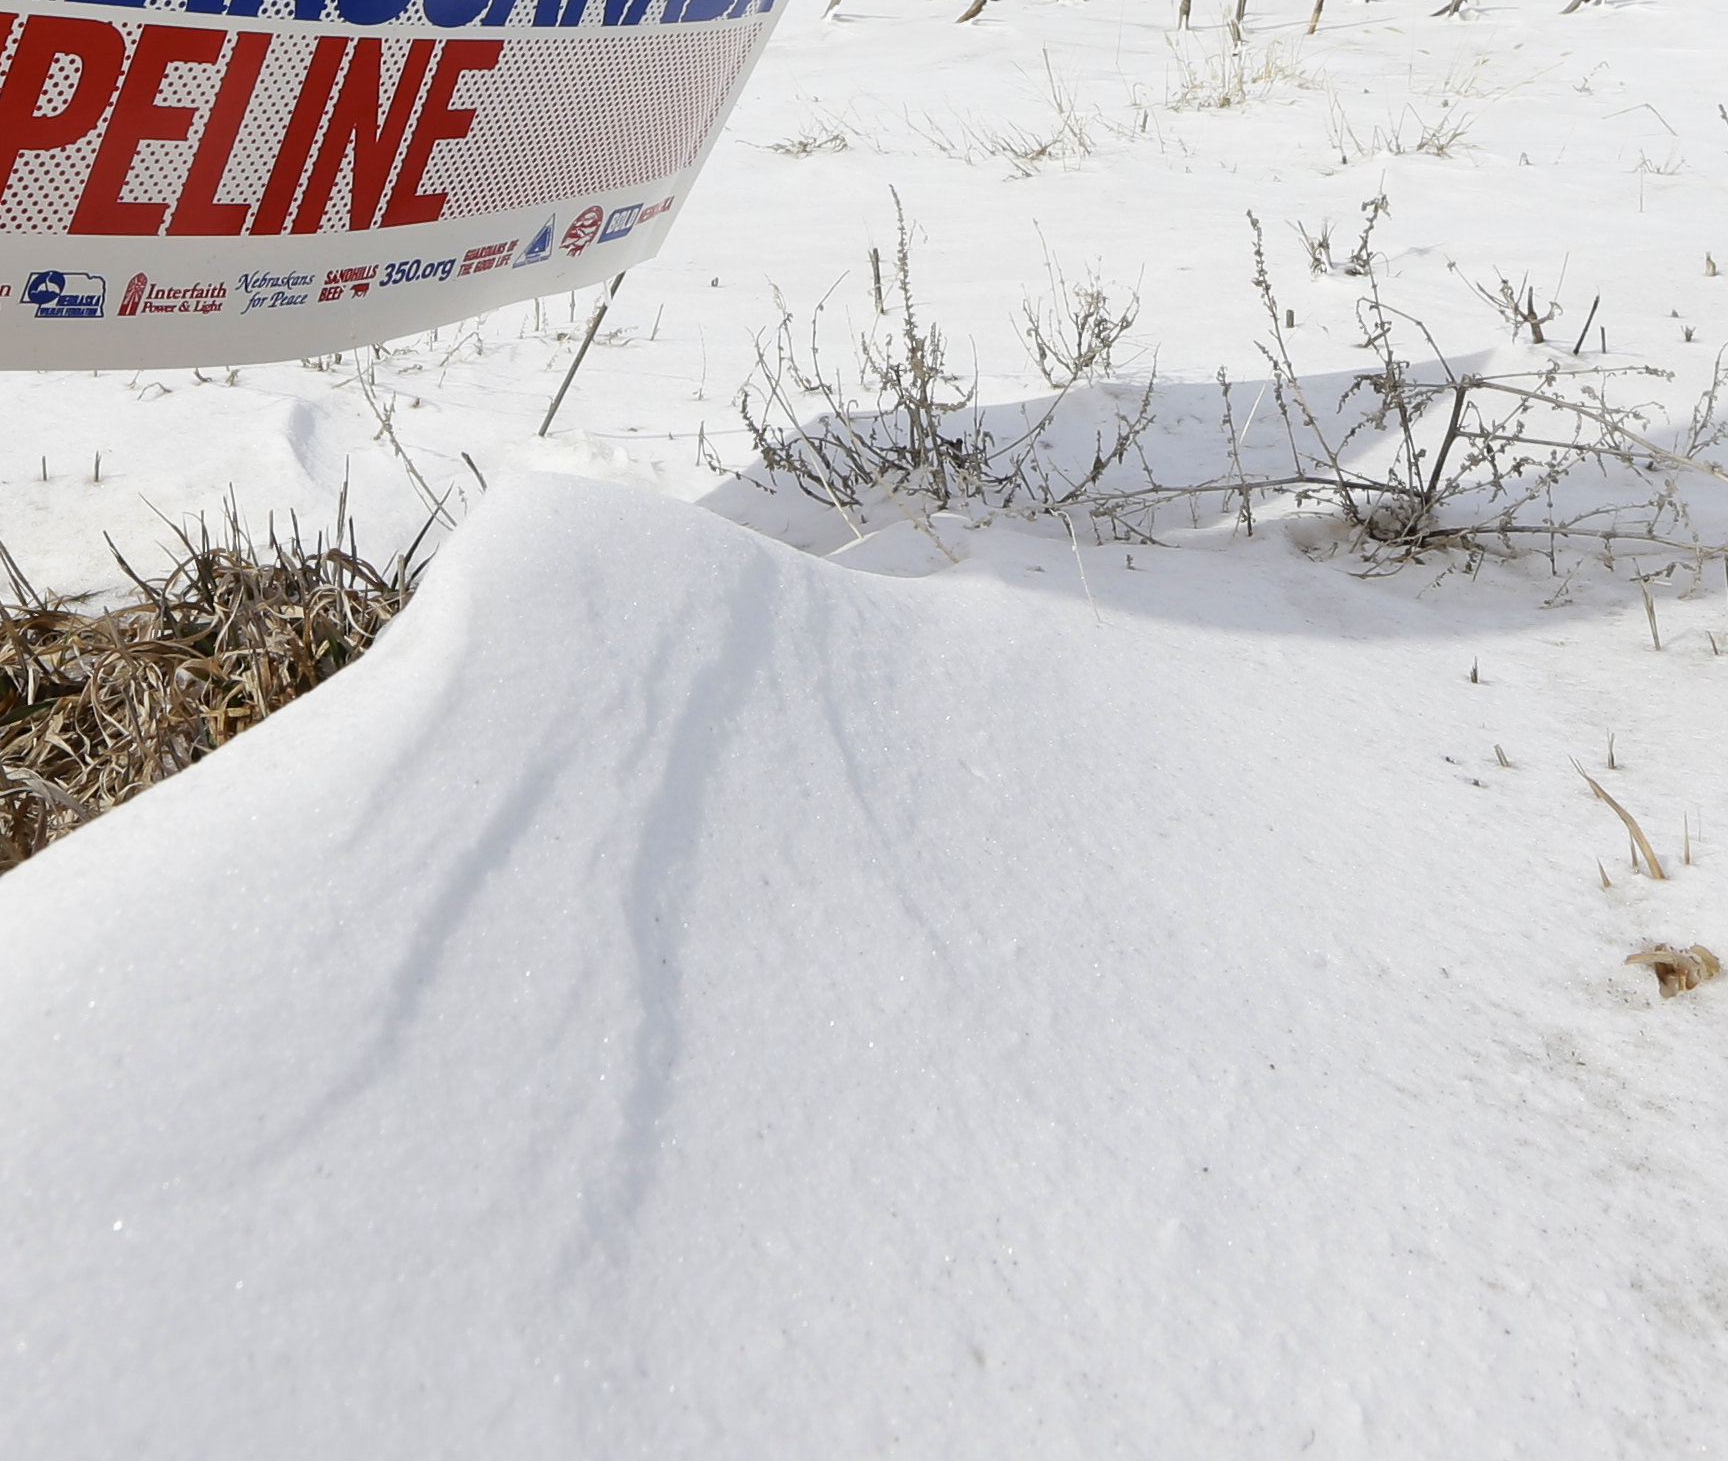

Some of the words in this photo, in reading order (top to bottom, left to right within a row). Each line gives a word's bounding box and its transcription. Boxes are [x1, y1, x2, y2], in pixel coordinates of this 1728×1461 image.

[605, 207, 639, 234] BOLD
[235, 270, 315, 293] Nebraskans
[324, 264, 379, 285] SANDHILLS
[379, 258, 457, 287] 350.org
[146, 283, 227, 300] Interfaith
[317, 285, 346, 302] BEEF
[141, 301, 175, 314] Power
[177, 301, 189, 314] &
[190, 300, 223, 315] Light
[240, 293, 267, 316] for
[268, 290, 308, 309] Peace
